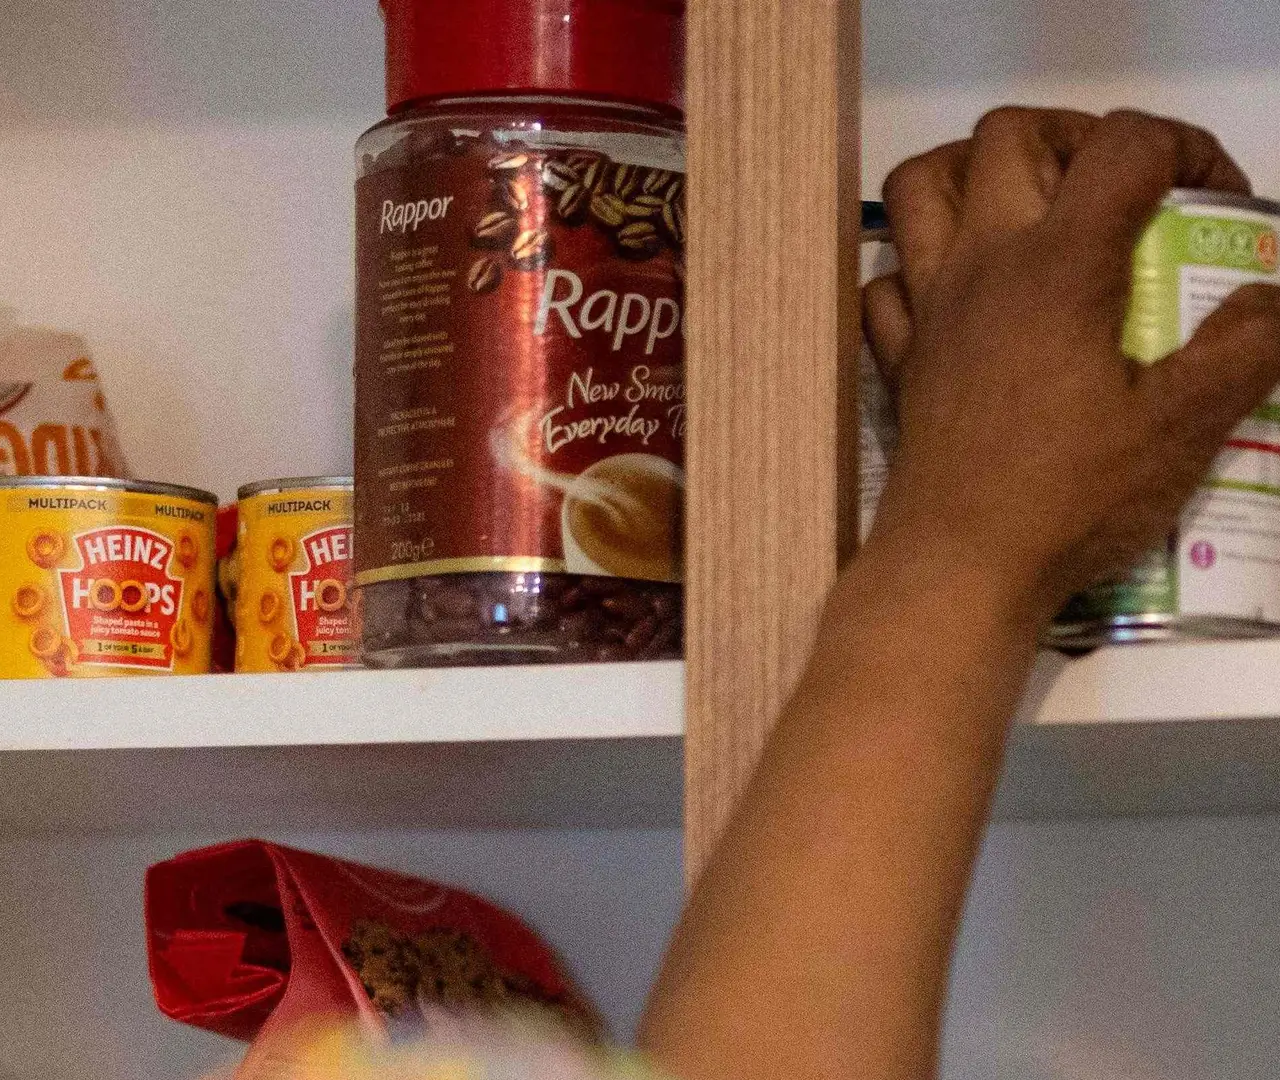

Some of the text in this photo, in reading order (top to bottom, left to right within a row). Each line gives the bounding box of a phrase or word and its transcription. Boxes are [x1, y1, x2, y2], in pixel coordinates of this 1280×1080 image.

[380, 196, 454, 235] Rappor
[532, 268, 685, 355] Rapp
[568, 366, 620, 409] New
[540, 404, 661, 454] Everyday
[28, 497, 107, 511] MULTIPACK
[268, 500, 331, 515] MULTIPACK
[84, 534, 169, 570] HEINZ
[72, 577, 175, 616] HOOPS
[90, 627, 161, 638] juicy tomato sauce
[93, 616, 123, 628] Shaped
[124, 619, 145, 629] pasta
[315, 626, 334, 637] juicy
[319, 616, 348, 627] Shaped
